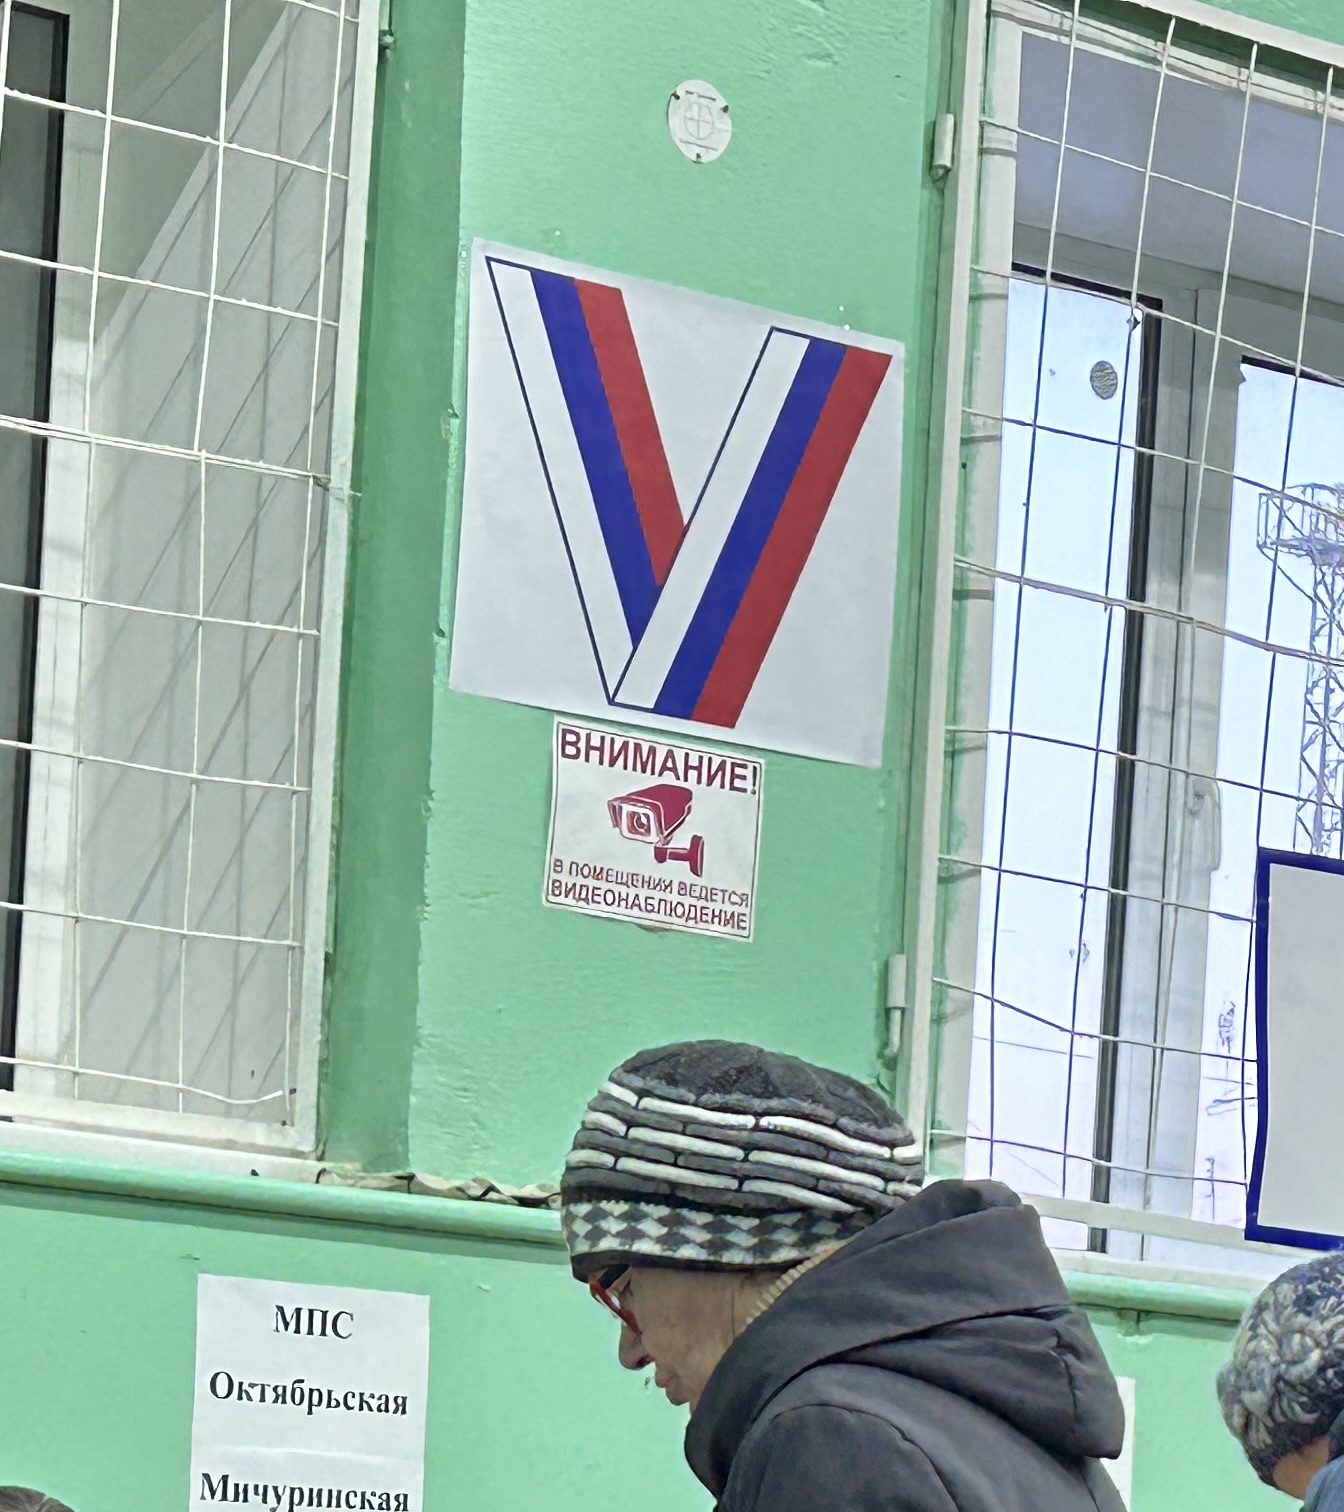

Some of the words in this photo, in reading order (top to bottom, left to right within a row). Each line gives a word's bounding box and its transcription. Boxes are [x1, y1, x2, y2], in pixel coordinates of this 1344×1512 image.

[561, 728, 758, 795] ВНИМАНИЕ!
[550, 879, 748, 931] ВИДЕОНАБЛЮДЕНИЕ
[552, 858, 564, 874] В
[569, 861, 674, 895] ПОМЕЩЕНИИ
[678, 880, 750, 908] ВЕДЕТСЯ
[273, 1304, 355, 1340] МПС
[208, 1370, 408, 1416] Октябрьская
